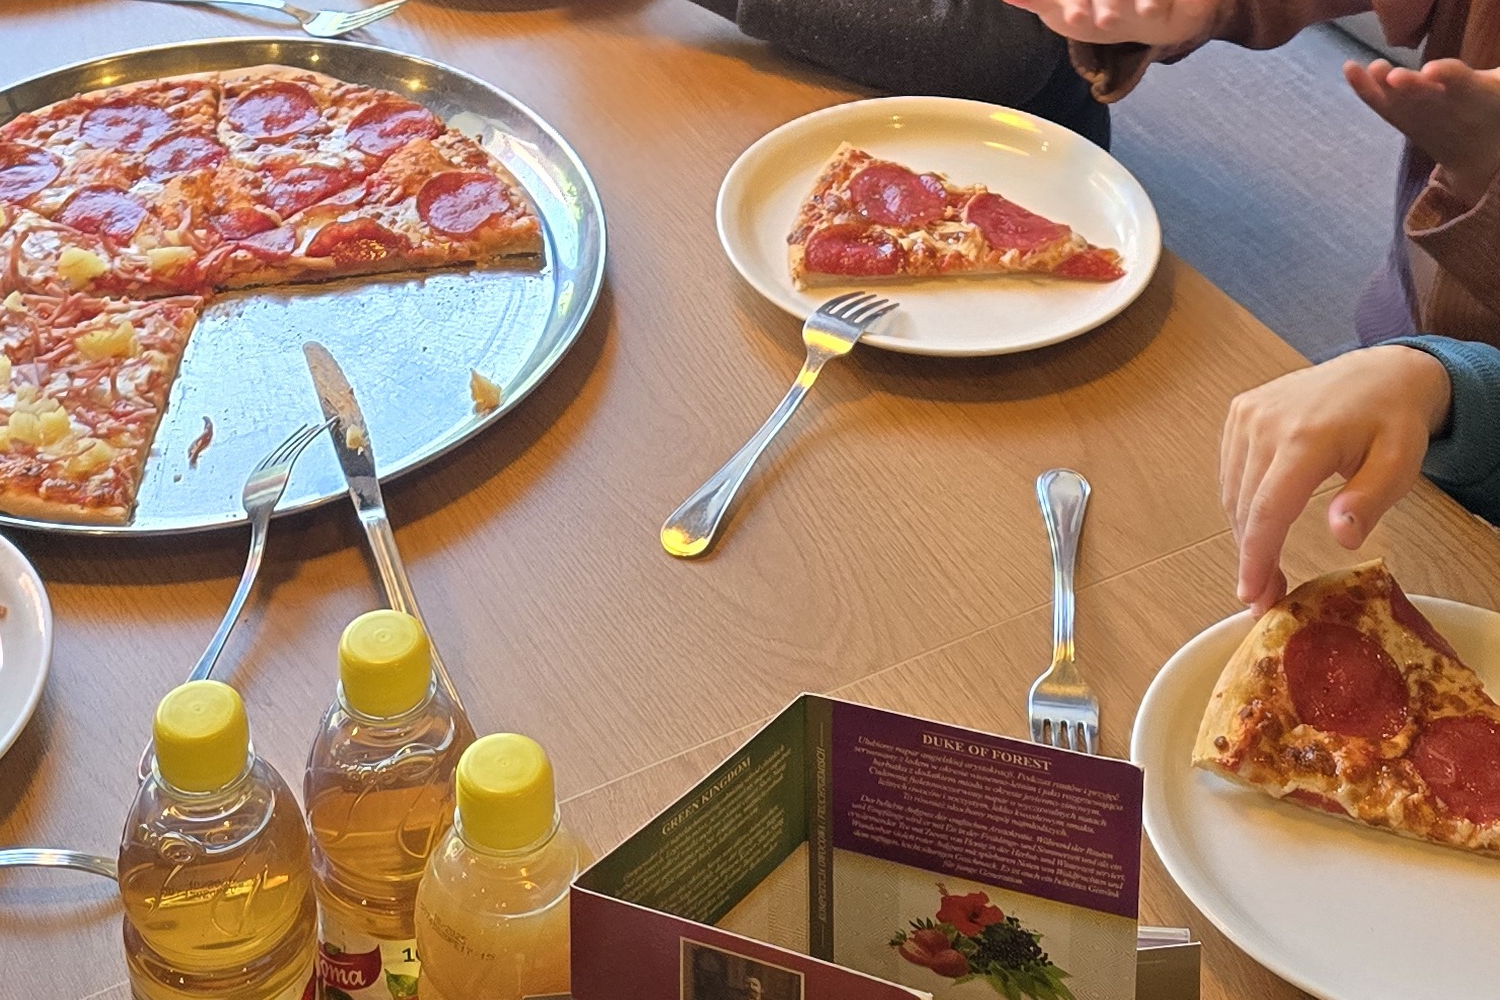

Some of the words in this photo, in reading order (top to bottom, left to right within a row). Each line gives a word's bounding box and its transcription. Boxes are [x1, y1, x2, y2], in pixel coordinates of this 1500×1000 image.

[922, 734, 964, 752] DUKE
[968, 744, 989, 757] OF
[992, 750, 1052, 771] FOREST
[661, 803, 700, 835] GREEN
[700, 756, 751, 805] KINGDOM
